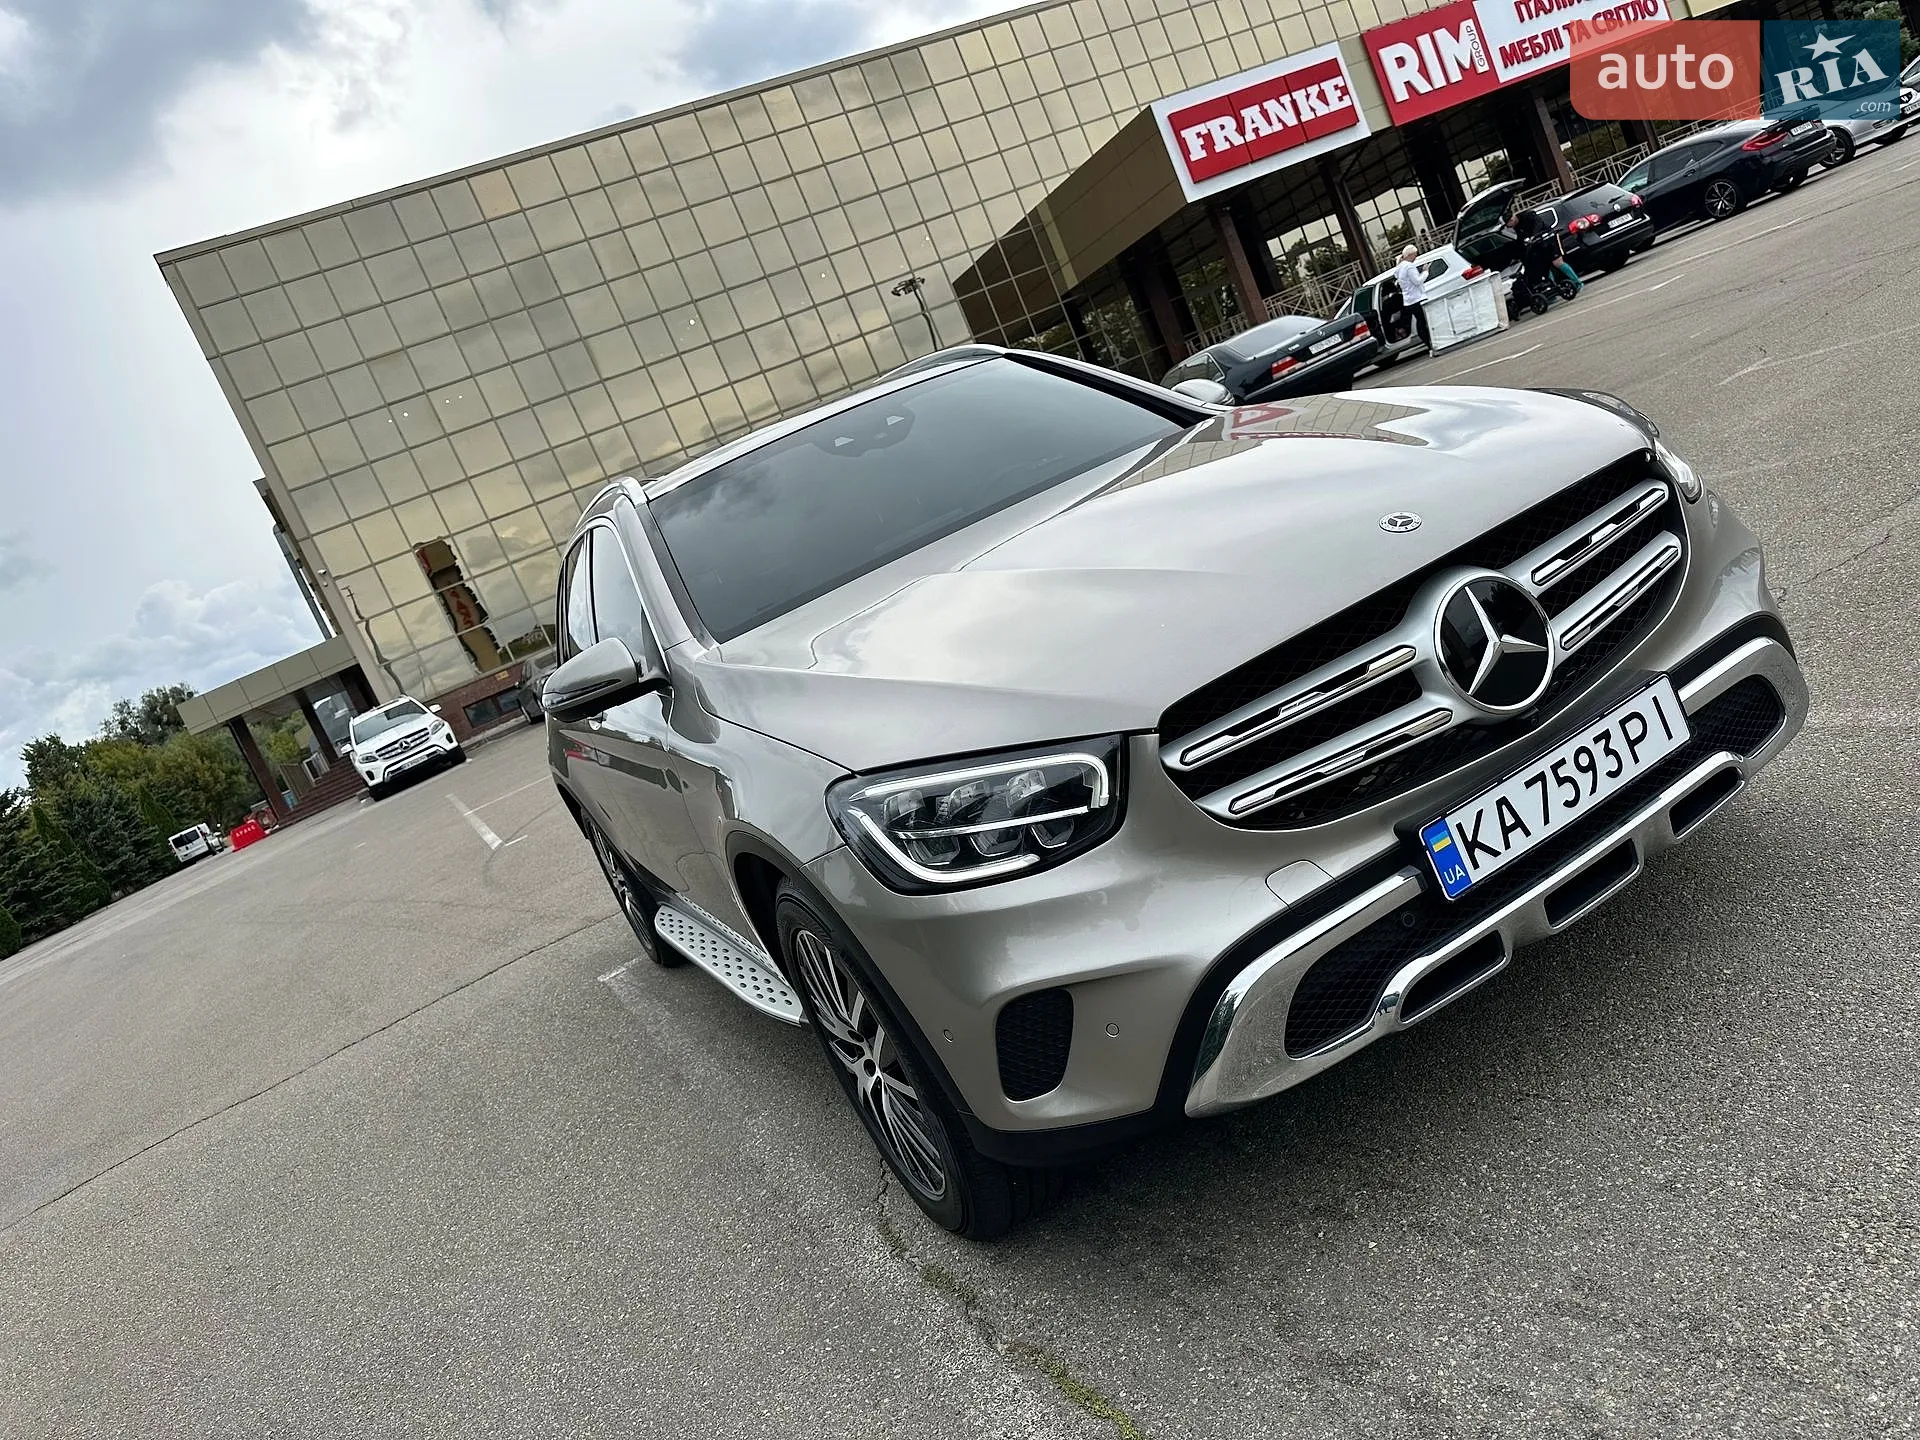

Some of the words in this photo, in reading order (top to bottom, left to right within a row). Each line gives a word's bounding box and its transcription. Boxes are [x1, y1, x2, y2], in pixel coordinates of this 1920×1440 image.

[1378, 18, 1490, 103] RIM
[1465, 25, 1486, 67] GROUP
[1498, 27, 1565, 69] МЕБЛІ
[1563, 18, 1592, 45] ТА
[1591, 0, 1660, 35] СВІТЛО
[1180, 76, 1353, 162] FRANKE
[1523, 728, 1623, 827] 7593
[1443, 863, 1466, 885] UA
